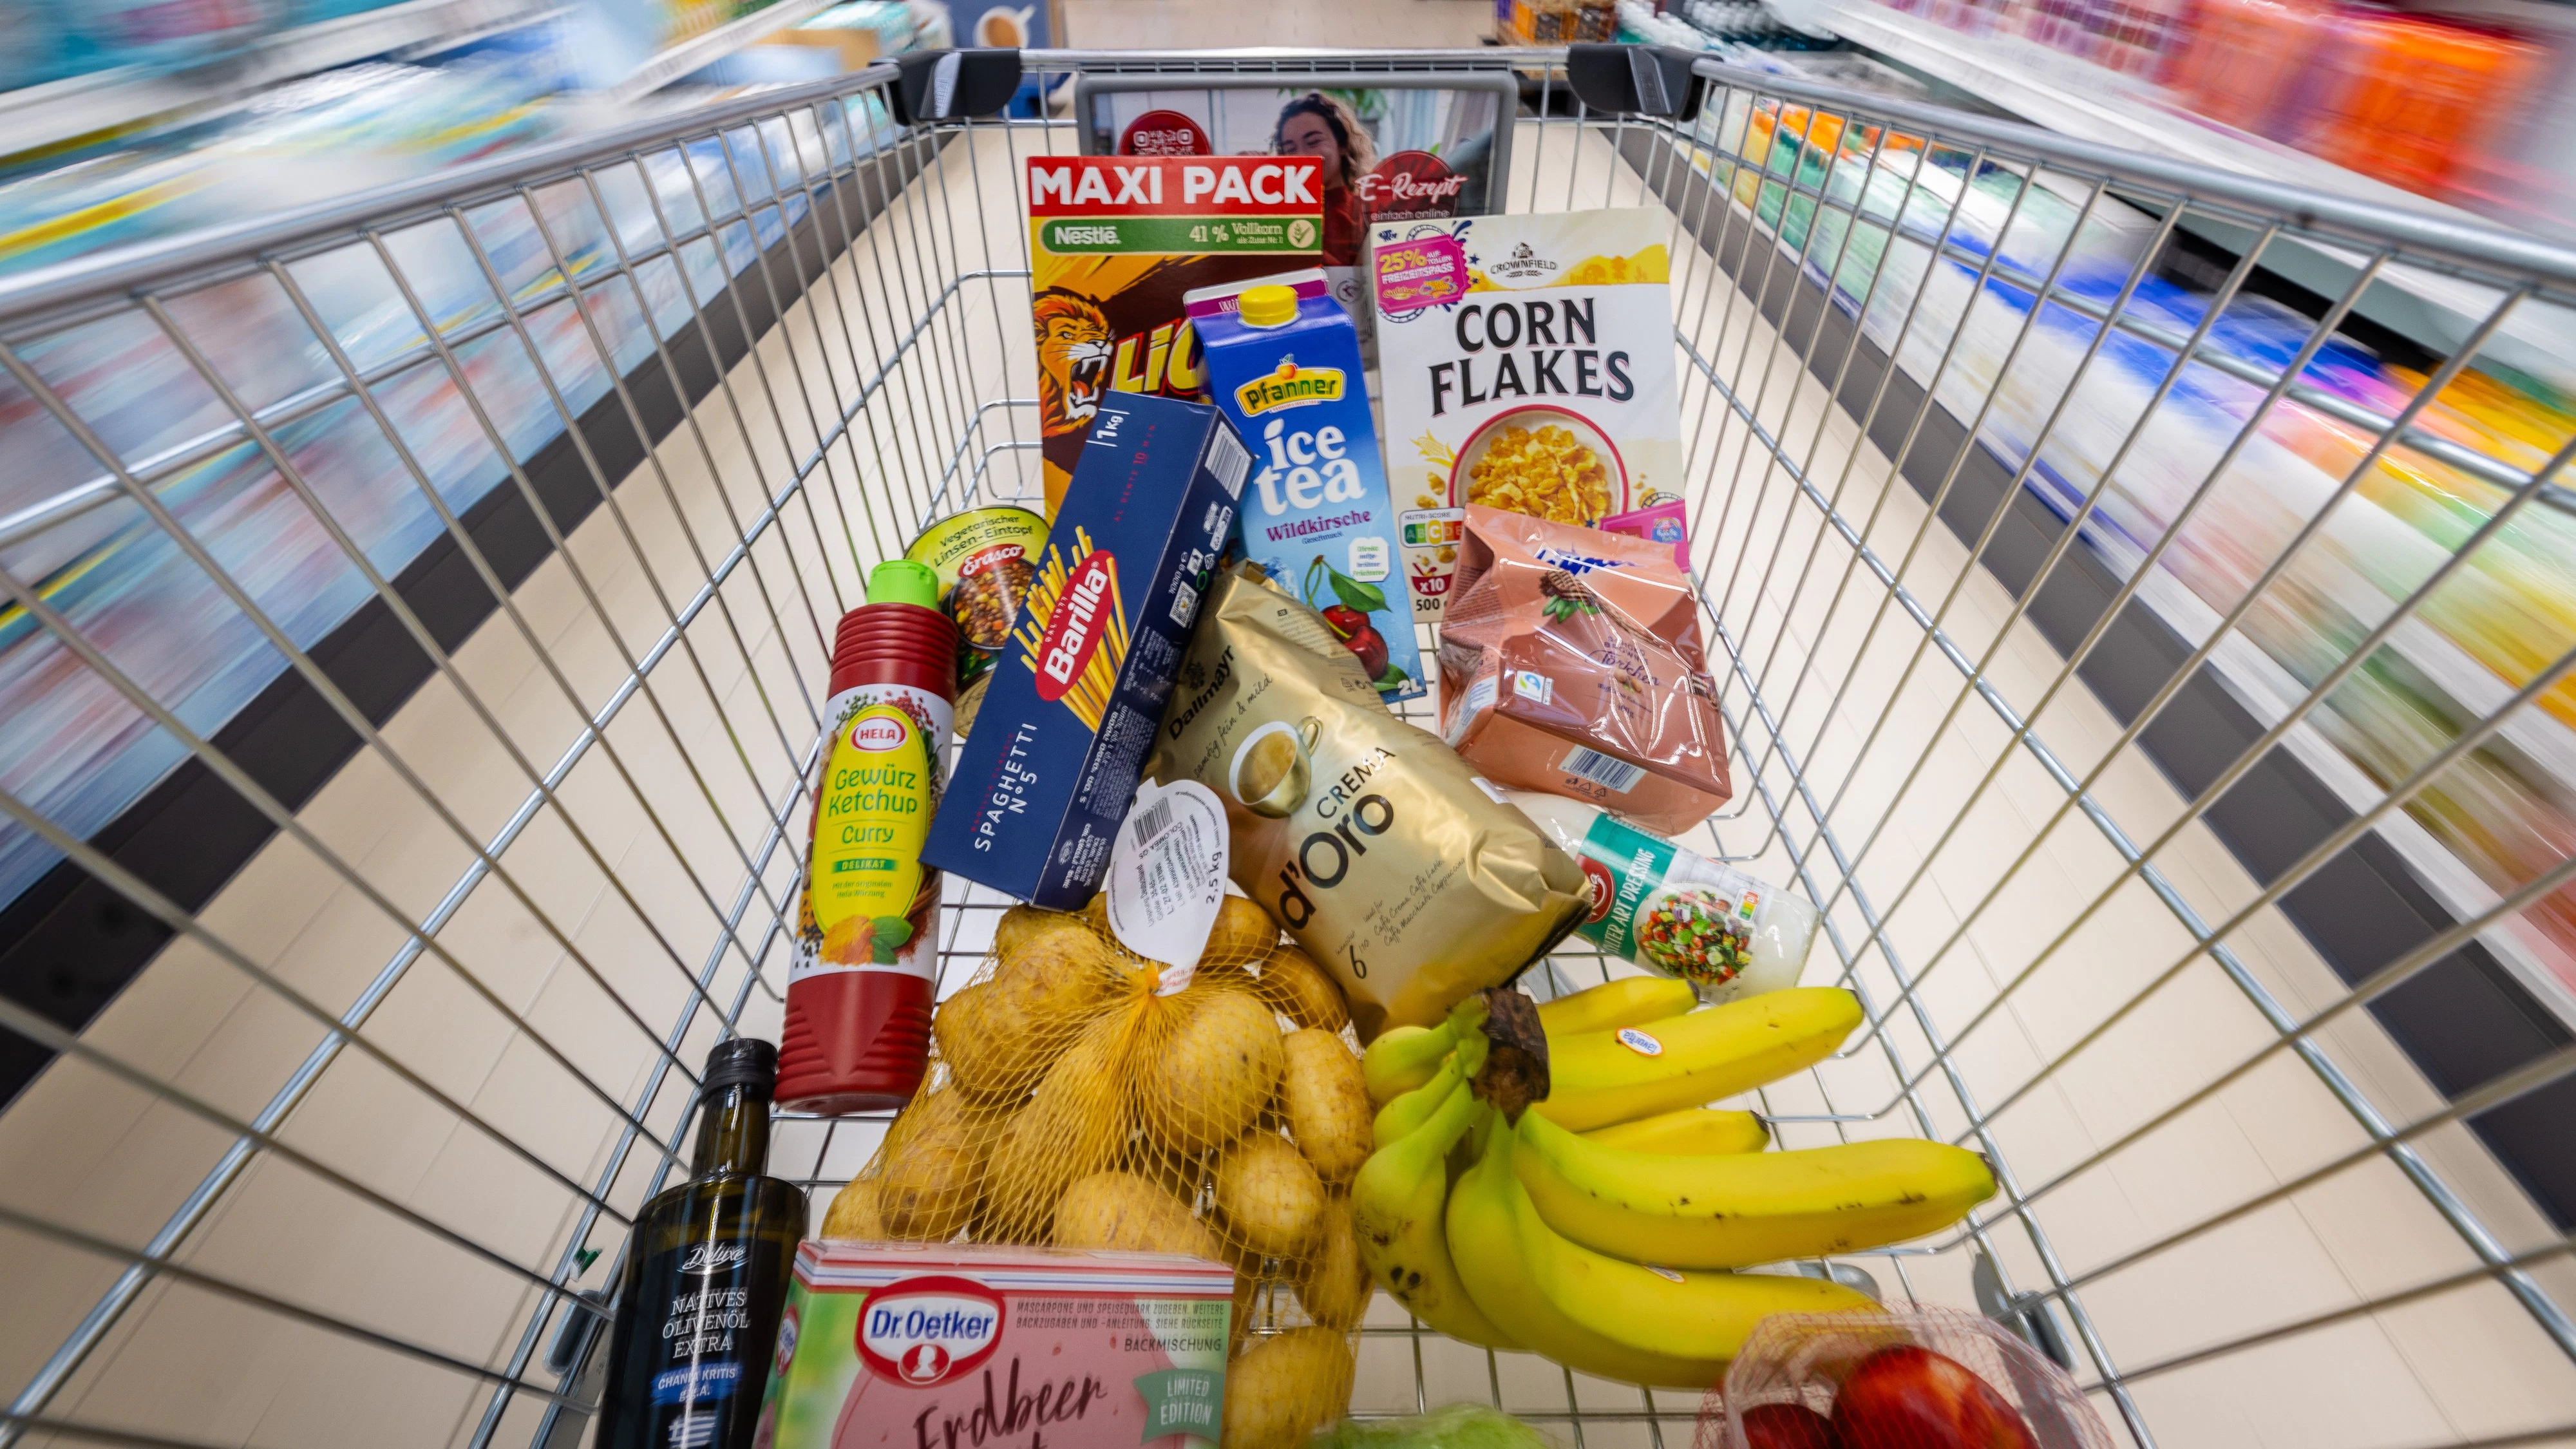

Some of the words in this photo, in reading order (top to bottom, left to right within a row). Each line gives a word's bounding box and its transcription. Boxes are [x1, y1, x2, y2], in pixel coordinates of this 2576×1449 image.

[1030, 166, 1162, 205] MAXI
[1183, 164, 1318, 205] PACK
[1354, 172, 1469, 204] E-Rezept
[1370, 209, 1414, 222] einfach
[1414, 208, 1450, 220] online
[1189, 225, 1209, 242] 41
[1211, 225, 1230, 242] %
[1231, 222, 1283, 235] Vollkorn
[1379, 248, 1428, 274] 25%
[1381, 262, 1455, 284] FREIZEITSPASS
[1490, 259, 1559, 275] CROWNFIELD
[1455, 297, 1596, 353] CORN
[1427, 350, 1634, 418] FLAKES
[1264, 417, 1347, 470] ice
[1133, 451, 1149, 466] 10
[1253, 458, 1367, 515] tea
[939, 515, 1021, 547] Vegetarischer
[1265, 510, 1372, 542] Wildkirsche
[1406, 529, 1416, 538] A
[1418, 528, 1425, 538] B
[1429, 525, 1440, 538] C
[934, 525, 1034, 568] Linsen-Eintopf
[961, 545, 1024, 577] Erasco
[1167, 570, 1182, 594] 1000
[1419, 577, 1446, 593] x10
[1416, 597, 1440, 612] 500
[1043, 568, 1110, 685] Barilla
[1169, 643, 1236, 740] Dallmayr
[1397, 679, 1423, 696] 2L
[859, 726, 896, 741] HELA
[1190, 737, 1224, 779] samtig
[1215, 714, 1238, 746] fein
[1231, 700, 1247, 715] &
[1242, 672, 1274, 705] mild
[835, 764, 918, 791] Gewürz
[972, 721, 1037, 852] SPAGHETTI
[1315, 746, 1397, 819] CREMA
[828, 789, 918, 818] Ketchup
[841, 826, 894, 844] Curry
[1149, 821, 1183, 849] COLOMBA
[841, 859, 887, 871] DELIKAT
[1209, 851, 1222, 875] kg
[1621, 847, 1657, 904] DRESSING
[855, 879, 893, 888] originalen
[1206, 877, 1219, 904] 2,5
[1613, 893, 1634, 924] ART
[1349, 945, 1367, 980] 6
[681, 1241, 748, 1269] Deluxe
[670, 1290, 746, 1316] NATIVES
[1016, 1301, 1074, 1314] MASCARPONE
[1077, 1302, 1094, 1314] UND
[1097, 1302, 1150, 1315] SPEISEQUARK
[1193, 1303, 1224, 1316] WEITERE
[662, 1311, 748, 1340] OLIVENÖL
[1016, 1316, 1077, 1329] BACKZUGABEN
[1081, 1317, 1097, 1329] UND
[1155, 1317, 1178, 1329] SIEHE
[1180, 1316, 1223, 1330] RÜCKSEITE
[672, 1335, 733, 1359] EXTRA
[1124, 1337, 1222, 1352] BACKMISCHUNG
[658, 1372, 699, 1390] CHANIA
[701, 1367, 736, 1381] KRITIS
[1166, 1378, 1210, 1398] LIMITED
[913, 1357, 1108, 1449] Erdbeer
[1160, 1404, 1212, 1426] EDITION
